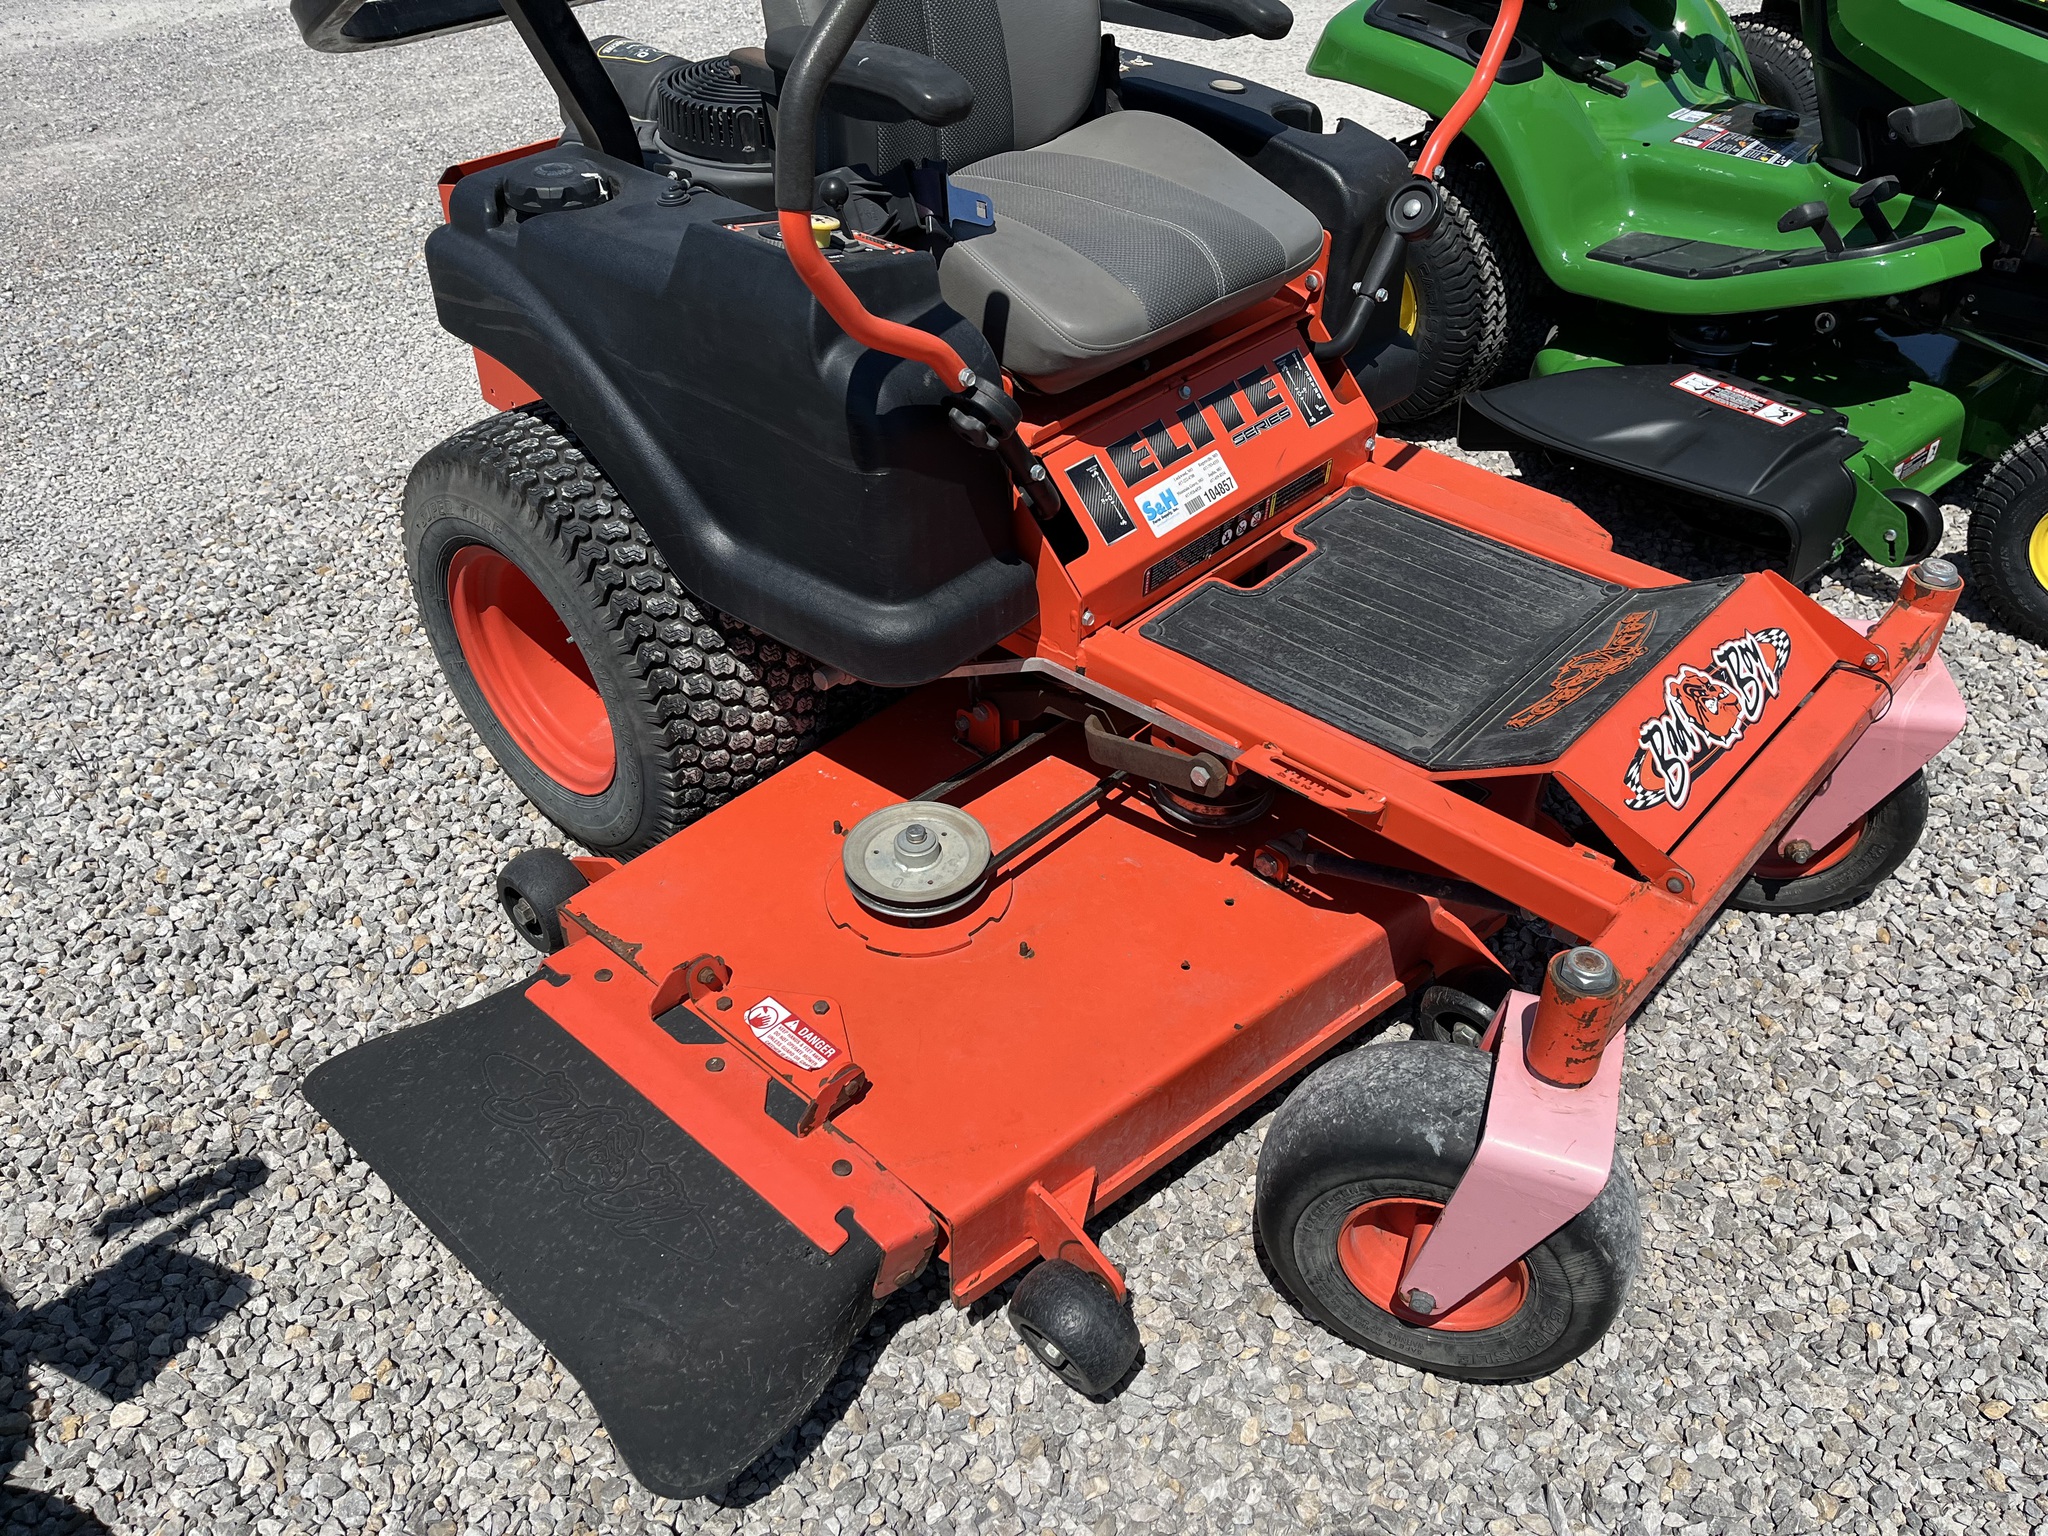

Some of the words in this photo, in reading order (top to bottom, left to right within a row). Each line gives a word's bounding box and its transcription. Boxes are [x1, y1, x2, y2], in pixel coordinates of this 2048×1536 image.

[1105, 364, 1286, 489] ELITE
[1231, 405, 1293, 448] SERIES
[1142, 487, 1179, 521] S&H
[1204, 476, 1234, 502] 104857
[459, 503, 503, 537] TURF
[1711, 628, 1780, 724] Boy
[1638, 702, 1704, 811] Bad
[767, 1034, 782, 1047] UNLESS
[781, 1045, 795, 1056] GUARD
[778, 1026, 788, 1034] KEEP
[787, 1033, 800, 1045] HANDS
[803, 1045, 813, 1054] FEET
[787, 1040, 804, 1055] OPERATE
[802, 1053, 818, 1066] MOWER
[797, 1026, 836, 1058] DANGER
[1386, 1339, 1422, 1355] SAFETY
[1457, 1305, 1566, 1366] CARLISLE
